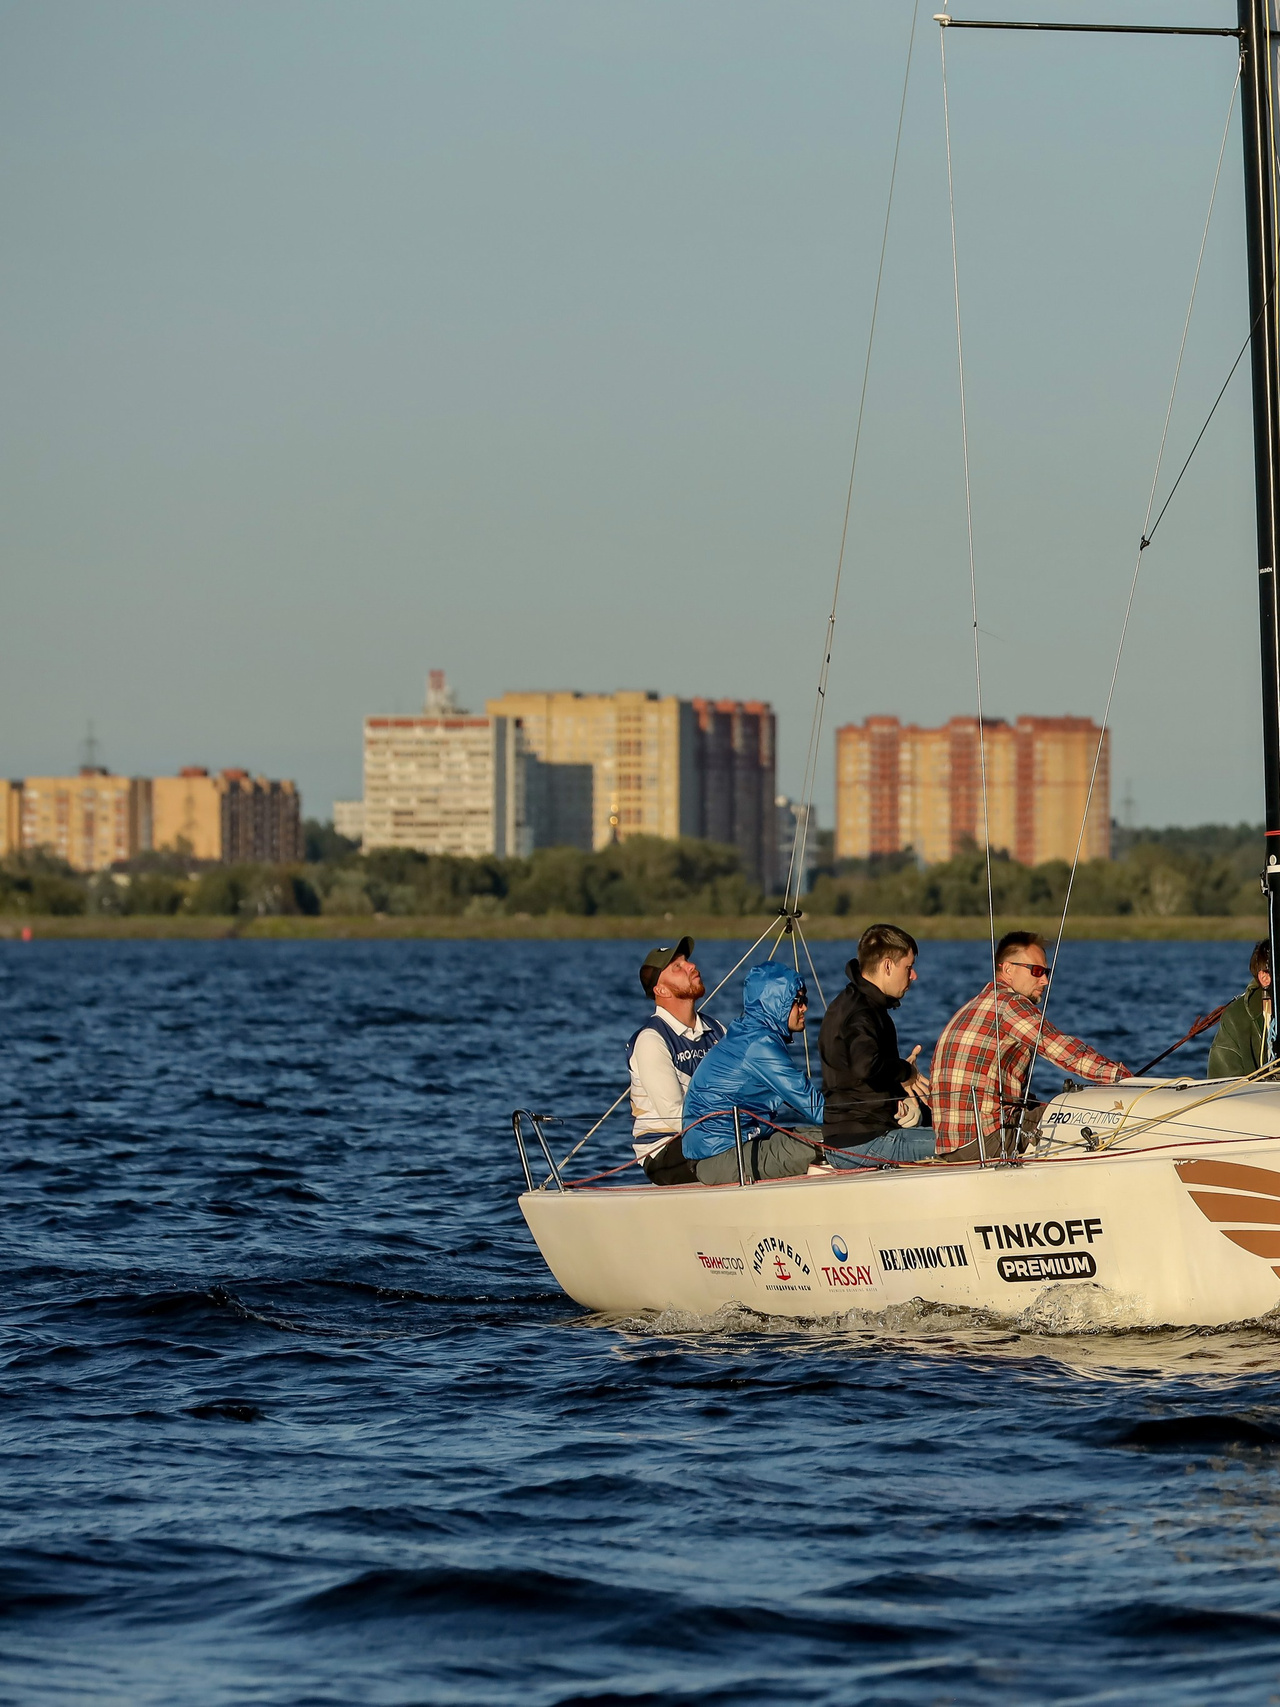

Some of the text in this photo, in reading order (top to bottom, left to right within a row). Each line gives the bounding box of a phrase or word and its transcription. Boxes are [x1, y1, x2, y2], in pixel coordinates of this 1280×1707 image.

[1047, 1111, 1122, 1125] PROYACHTING
[974, 1218, 1103, 1250] TINKOFF
[753, 1237, 811, 1276] МОРПРИБОР
[878, 1244, 969, 1272] ВЕДОМОСТИ
[1002, 1256, 1091, 1278] PREMIUM
[821, 1265, 874, 1287] TASSAY
